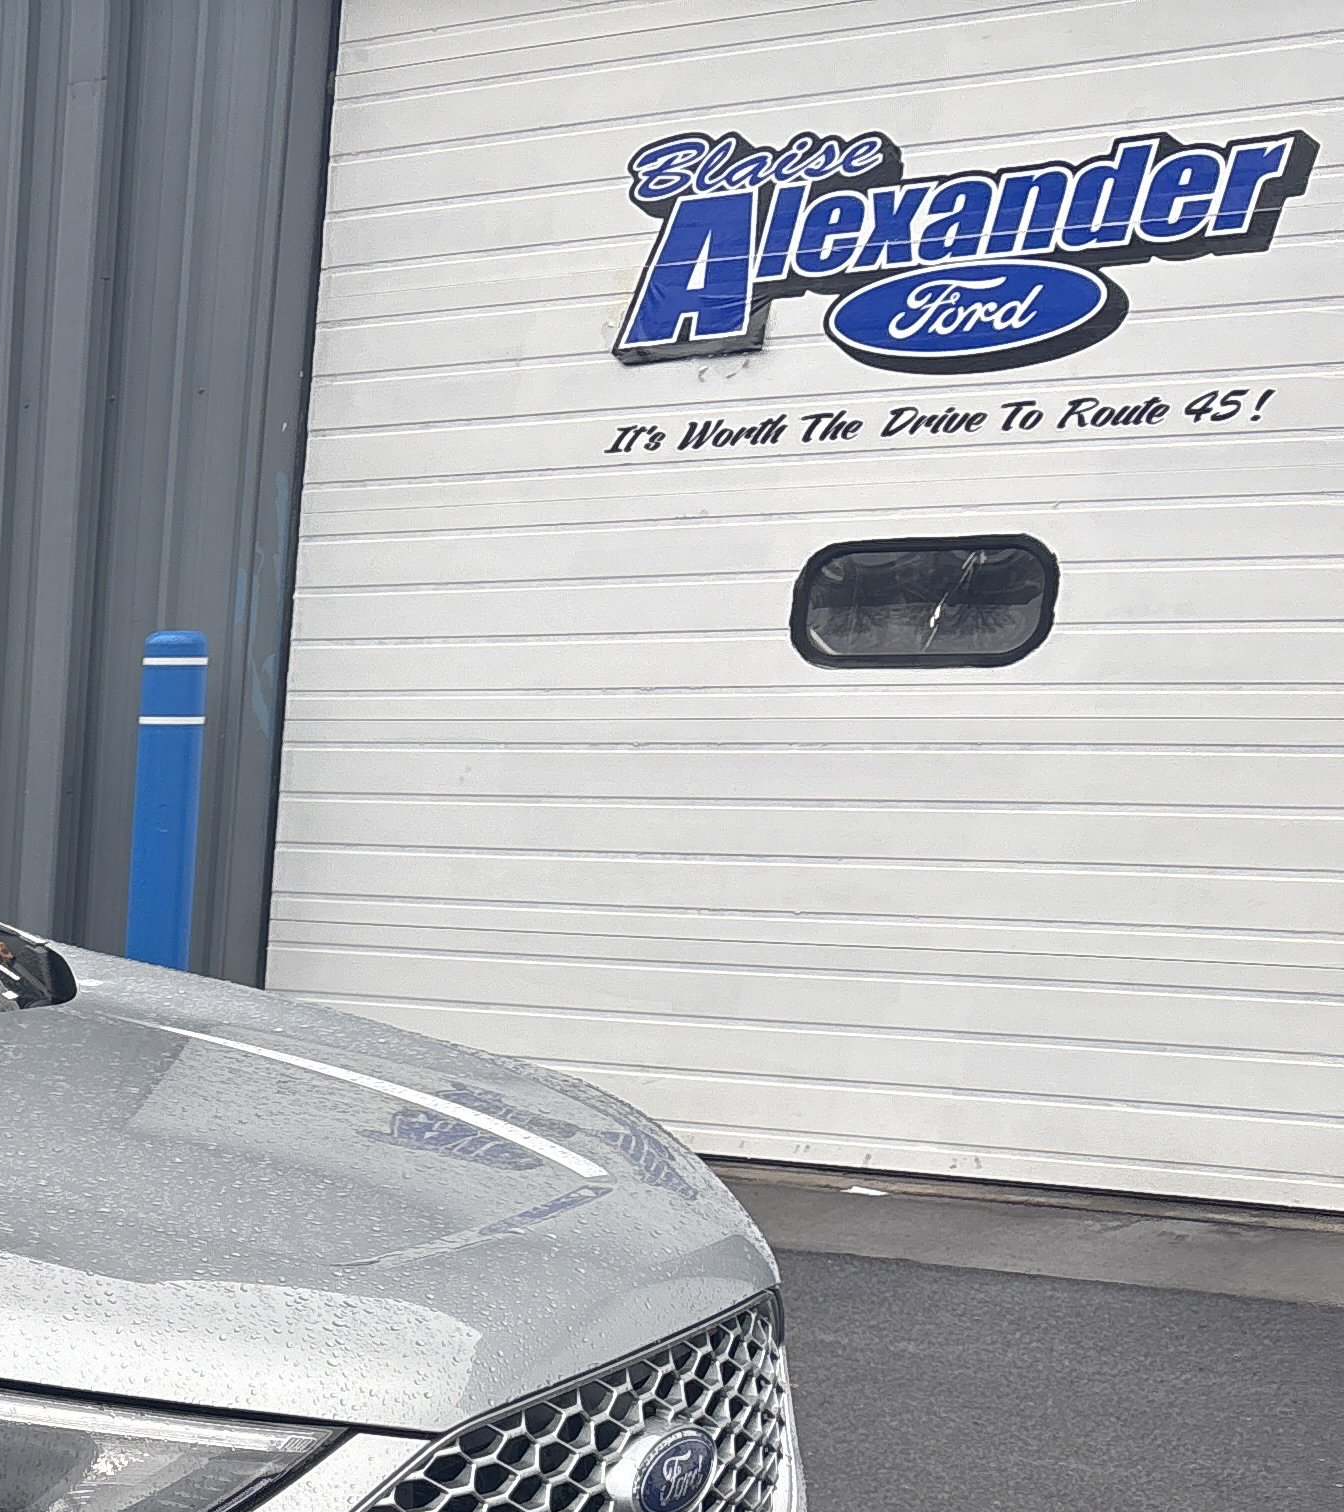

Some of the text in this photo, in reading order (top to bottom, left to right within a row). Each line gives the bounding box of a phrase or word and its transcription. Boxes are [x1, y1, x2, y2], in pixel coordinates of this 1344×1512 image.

[631, 131, 884, 200] Blaise
[619, 134, 1296, 349] Alexander
[887, 275, 1039, 338] Ford
[604, 424, 667, 454] It's
[676, 413, 788, 451] Worth
[800, 409, 864, 444] The
[879, 405, 989, 438] Drive
[1000, 399, 1044, 433] To
[1056, 396, 1171, 430] Route
[659, 1449, 704, 1507] Ford
